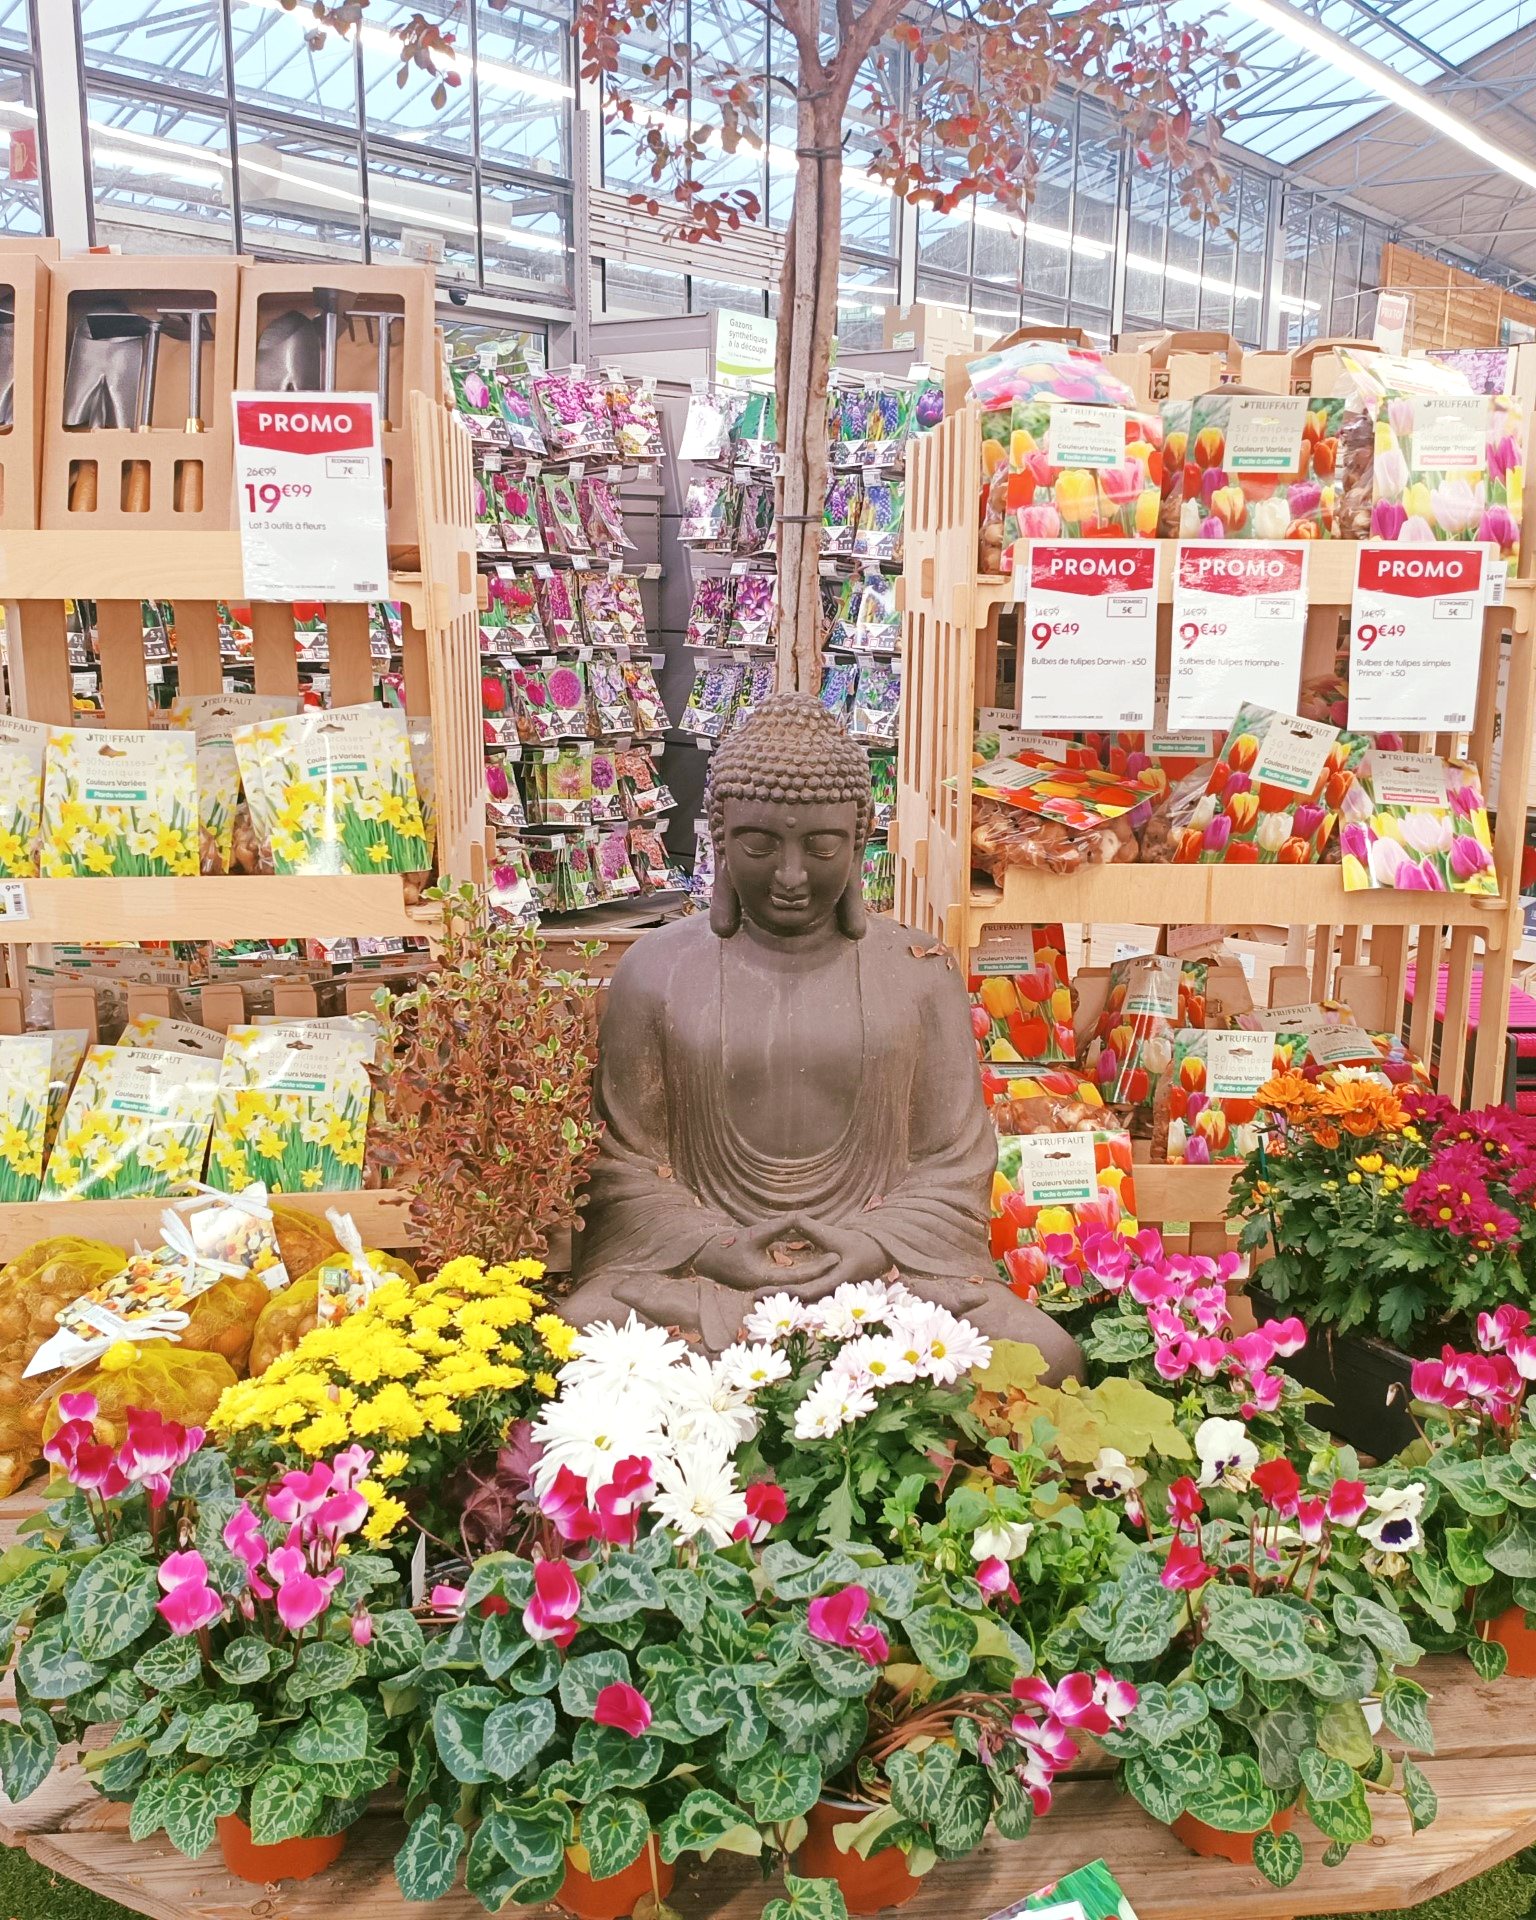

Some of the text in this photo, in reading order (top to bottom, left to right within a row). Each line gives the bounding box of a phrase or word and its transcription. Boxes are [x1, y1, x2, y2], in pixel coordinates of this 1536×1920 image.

[729, 318, 753, 330] Gazons
[1249, 401, 1300, 411] TRUFFAUT
[1432, 400, 1481, 410] TRUFFAUT
[258, 413, 353, 433] PROMO
[1233, 445, 1264, 453] Couleurs
[246, 467, 277, 477] 26€99
[343, 467, 354, 475] 7€
[249, 521, 263, 530] Lot
[264, 522, 270, 530] 3
[271, 522, 293, 530] outils
[303, 522, 327, 531] fleurs
[1050, 558, 1136, 576] PROMO
[1199, 559, 1285, 577] PROMO
[1377, 560, 1463, 578] PROMO
[1122, 606, 1132, 614] 5€
[1448, 608, 1458, 616] 5€
[1031, 657, 1057, 666] Bulbes
[1059, 657, 1068, 666] de
[1070, 657, 1096, 667] tulipes
[1097, 657, 1126, 666] Darwin
[1132, 657, 1147, 666] x50
[1179, 657, 1204, 666] Bulbes
[1205, 657, 1215, 666] de
[1217, 657, 1243, 667] tulipes
[1244, 657, 1280, 668] triomphe
[1356, 658, 1451, 668] Bulbes de tulipes simples
[1178, 667, 1193, 676] x50
[1391, 669, 1406, 677] x50
[207, 697, 253, 706] TRUFFAUT
[1290, 720, 1331, 738] TRUFFAUT
[94, 734, 146, 743] TRUFFAUT
[1016, 735, 1059, 747] TRUFFAUT
[1152, 734, 1181, 742] Couleurs
[1263, 758, 1291, 770] Couleurs
[1388, 754, 1434, 764] TRUFFAUT
[85, 778, 147, 787] Couleurs Variées
[1271, 1007, 1313, 1018] TRUFFAUT
[178, 1024, 224, 1045] TRUFFAUT
[1223, 1035, 1268, 1044] TRUFFAUT
[1213, 1073, 1243, 1081] Couleurs
[1038, 1136, 1086, 1146] TRUFFAUT
[1031, 1178, 1089, 1187] Couleurs Variées
